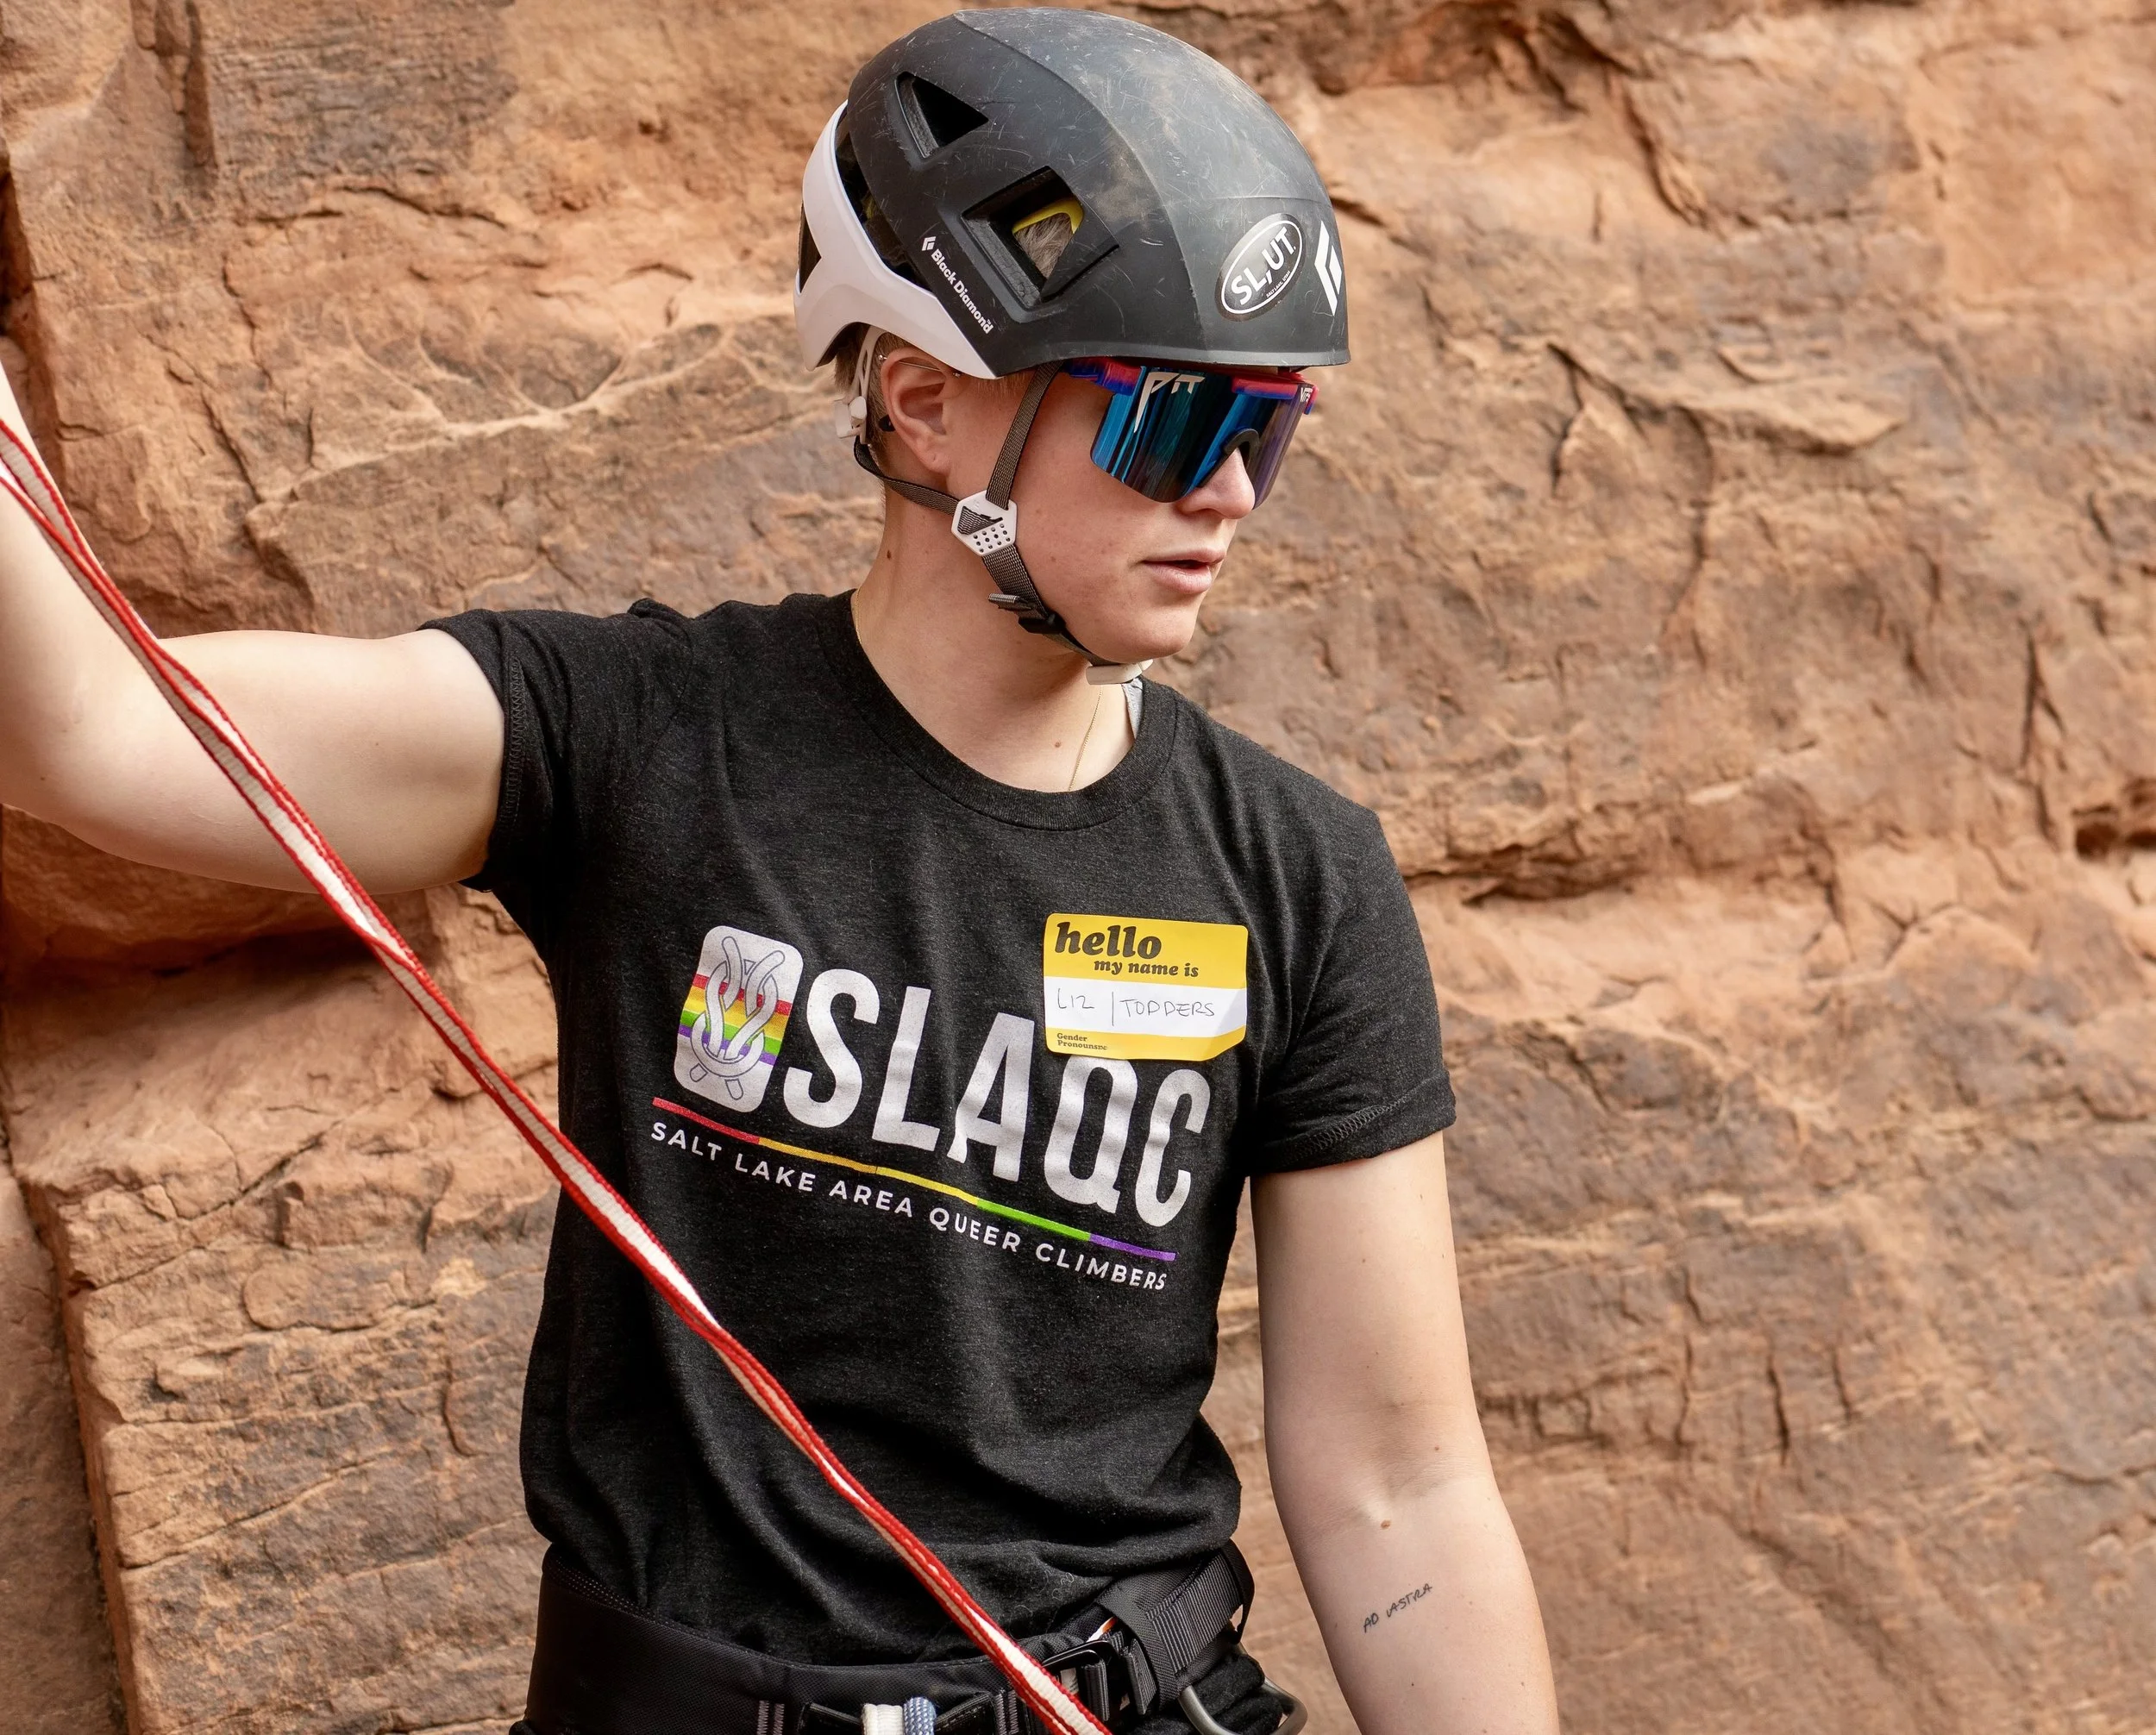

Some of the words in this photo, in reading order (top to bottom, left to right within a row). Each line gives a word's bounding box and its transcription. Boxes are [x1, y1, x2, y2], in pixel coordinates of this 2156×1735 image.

[931, 248, 956, 285] Black
[1055, 921, 1162, 959] hello
[1094, 960, 1122, 975] my
[1128, 961, 1179, 976] name
[1184, 962, 1200, 978] is
[1119, 999, 1216, 1018] TODDERS
[1056, 1032, 1088, 1043] Gender
[783, 968, 1211, 1228] SLAQC
[650, 1122, 722, 1162] SALT
[735, 1153, 817, 1193] LAKE
[829, 1180, 913, 1218] AREA
[929, 1207, 1022, 1253] QUEER
[1035, 1243, 1168, 1291] CLIMBERS
